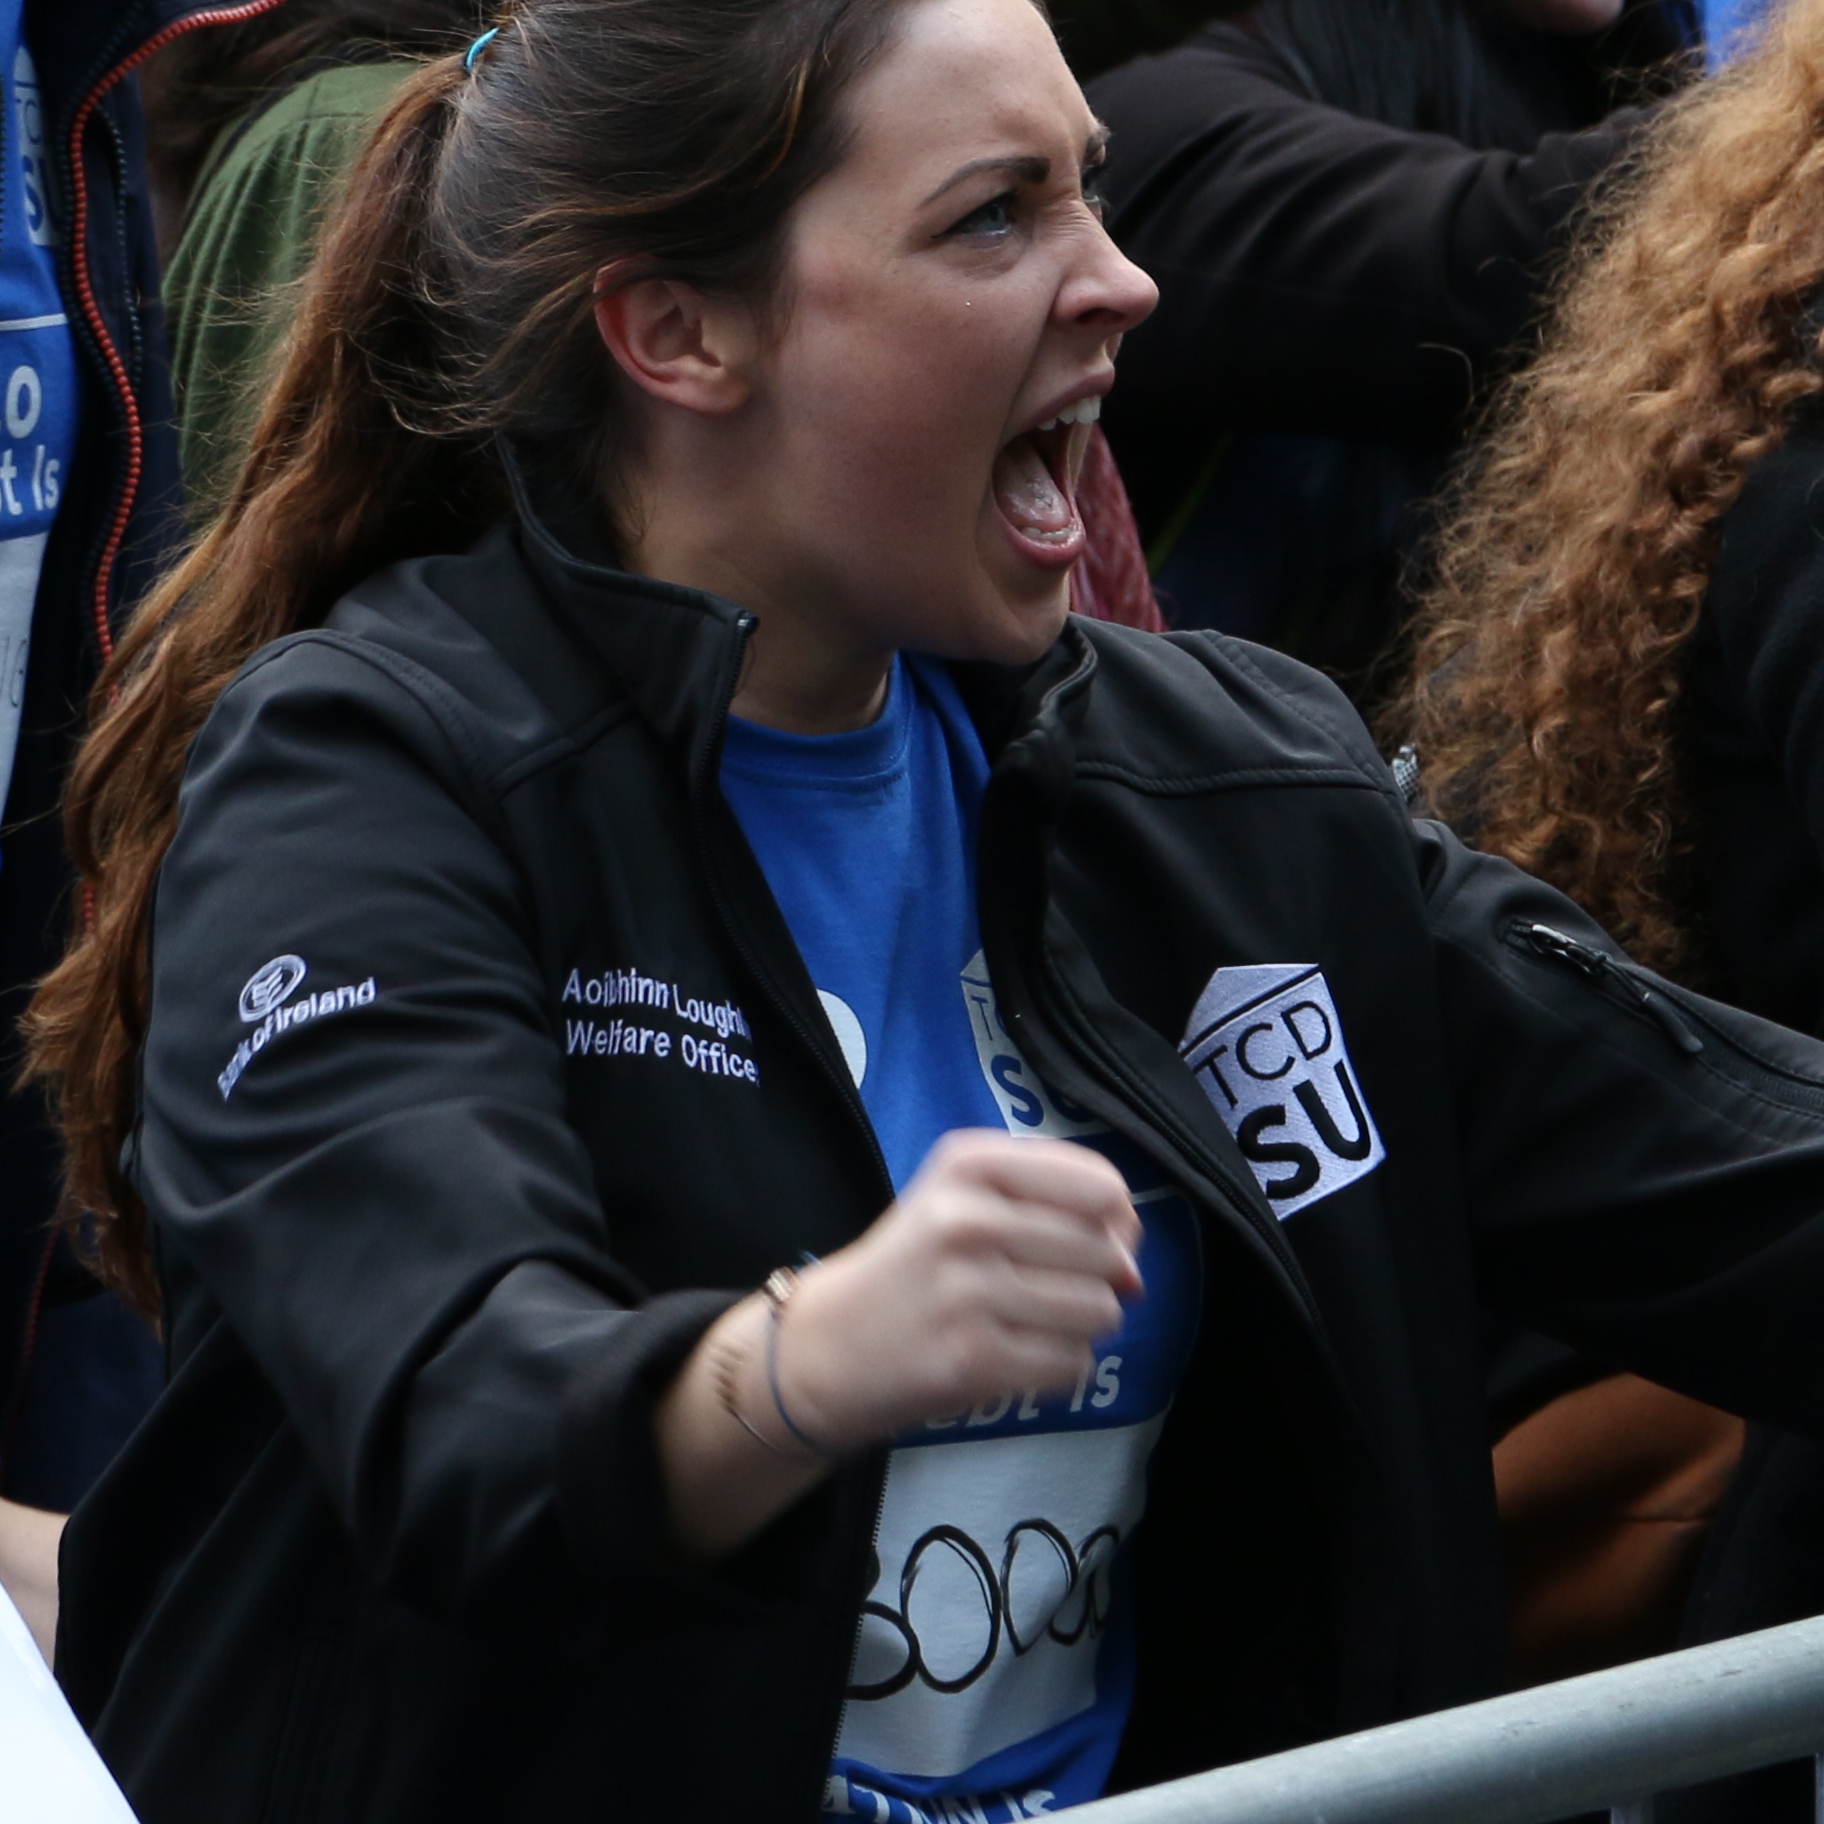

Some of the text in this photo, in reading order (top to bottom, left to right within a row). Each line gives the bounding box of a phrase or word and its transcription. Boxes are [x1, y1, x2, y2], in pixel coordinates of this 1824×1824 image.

[275, 976, 375, 1034] Ireland
[566, 1019, 671, 1057] Welfare
[1193, 1001, 1371, 1200] TCD SU
